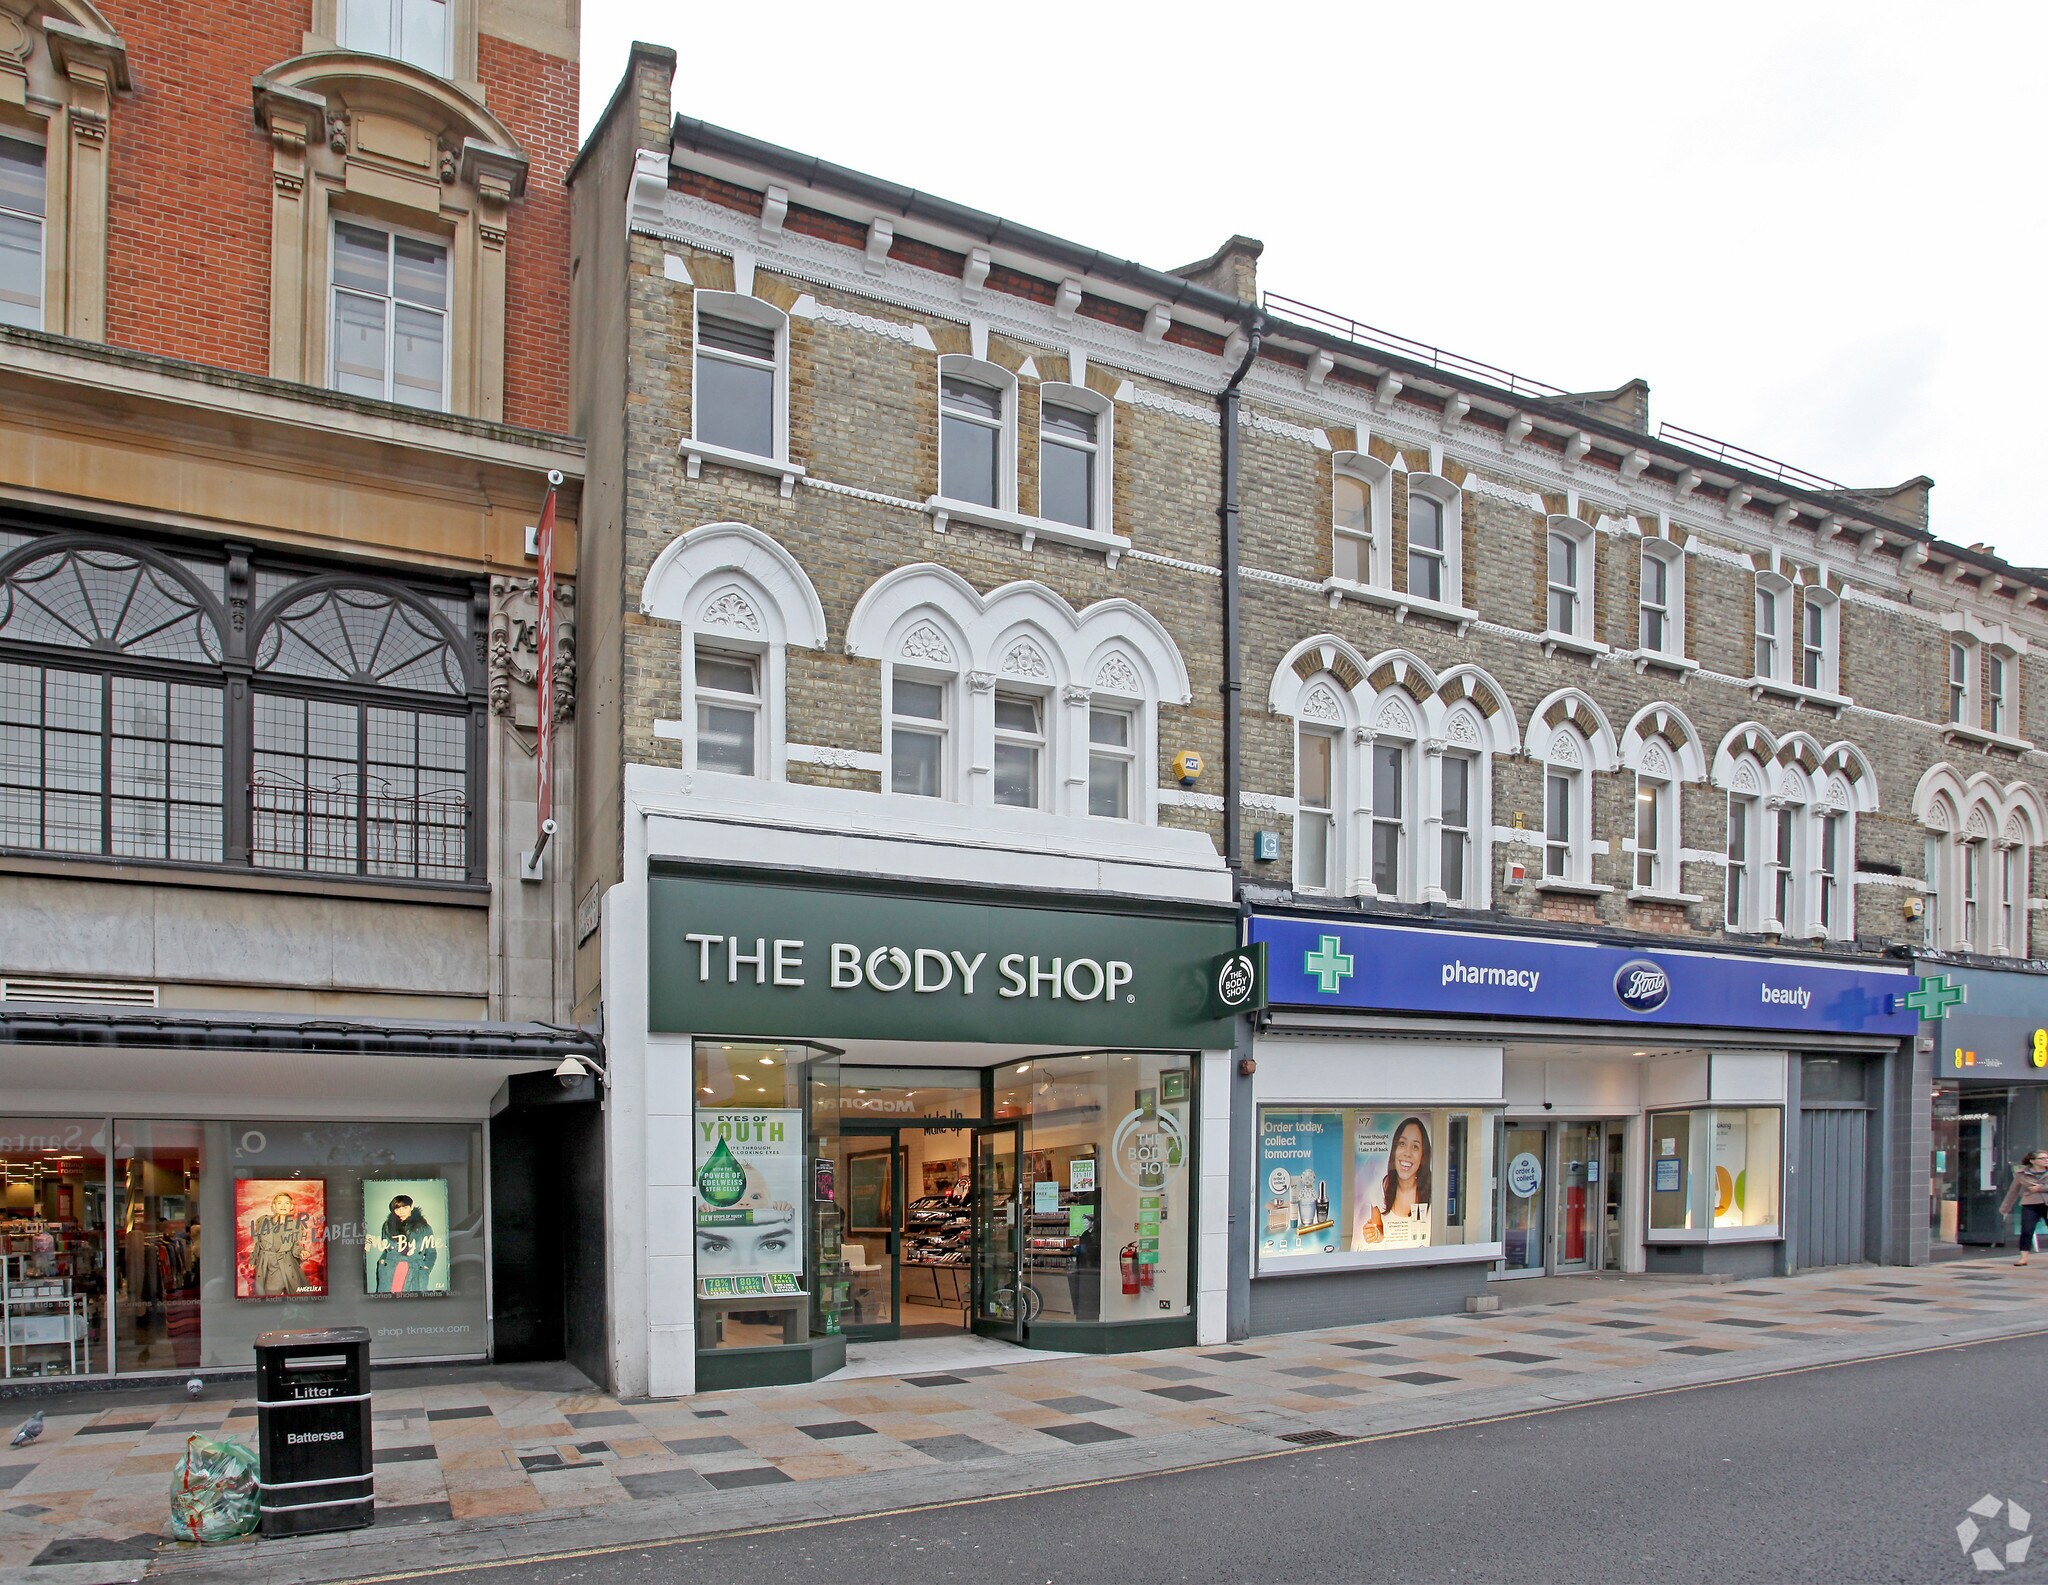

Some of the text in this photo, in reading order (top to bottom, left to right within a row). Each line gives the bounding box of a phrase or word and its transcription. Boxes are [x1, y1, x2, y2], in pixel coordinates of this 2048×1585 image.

[1185, 760, 1199, 769] ADT
[686, 933, 1134, 1002] THE BODY SHOP
[1230, 970, 1242, 980] THE
[1442, 960, 1540, 993] pharmacy
[1226, 976, 1247, 990] BODY
[1624, 970, 1666, 1000] Boots
[1227, 986, 1246, 998] SHOP
[1761, 983, 1811, 1009] beauty
[701, 1122, 785, 1141] YOUTH
[1264, 1122, 1324, 1134] Order today,
[1137, 1134, 1163, 1146] THE
[1265, 1136, 1296, 1147] collect
[1127, 1147, 1173, 1161] BODY
[1264, 1149, 1312, 1159] tomorrow
[1130, 1162, 1170, 1175] SHOP
[1516, 1174, 1535, 1182] collect
[250, 1212, 326, 1237] LAYER UP
[280, 1221, 369, 1245] WITH LABELS
[341, 1238, 356, 1246] FOR
[396, 1234, 416, 1256] By
[740, 1278, 760, 1286] 80%
[377, 1324, 470, 1338] shop tkmaxx.com
[294, 1386, 334, 1399] Litter
[287, 1430, 344, 1445] Battersea
